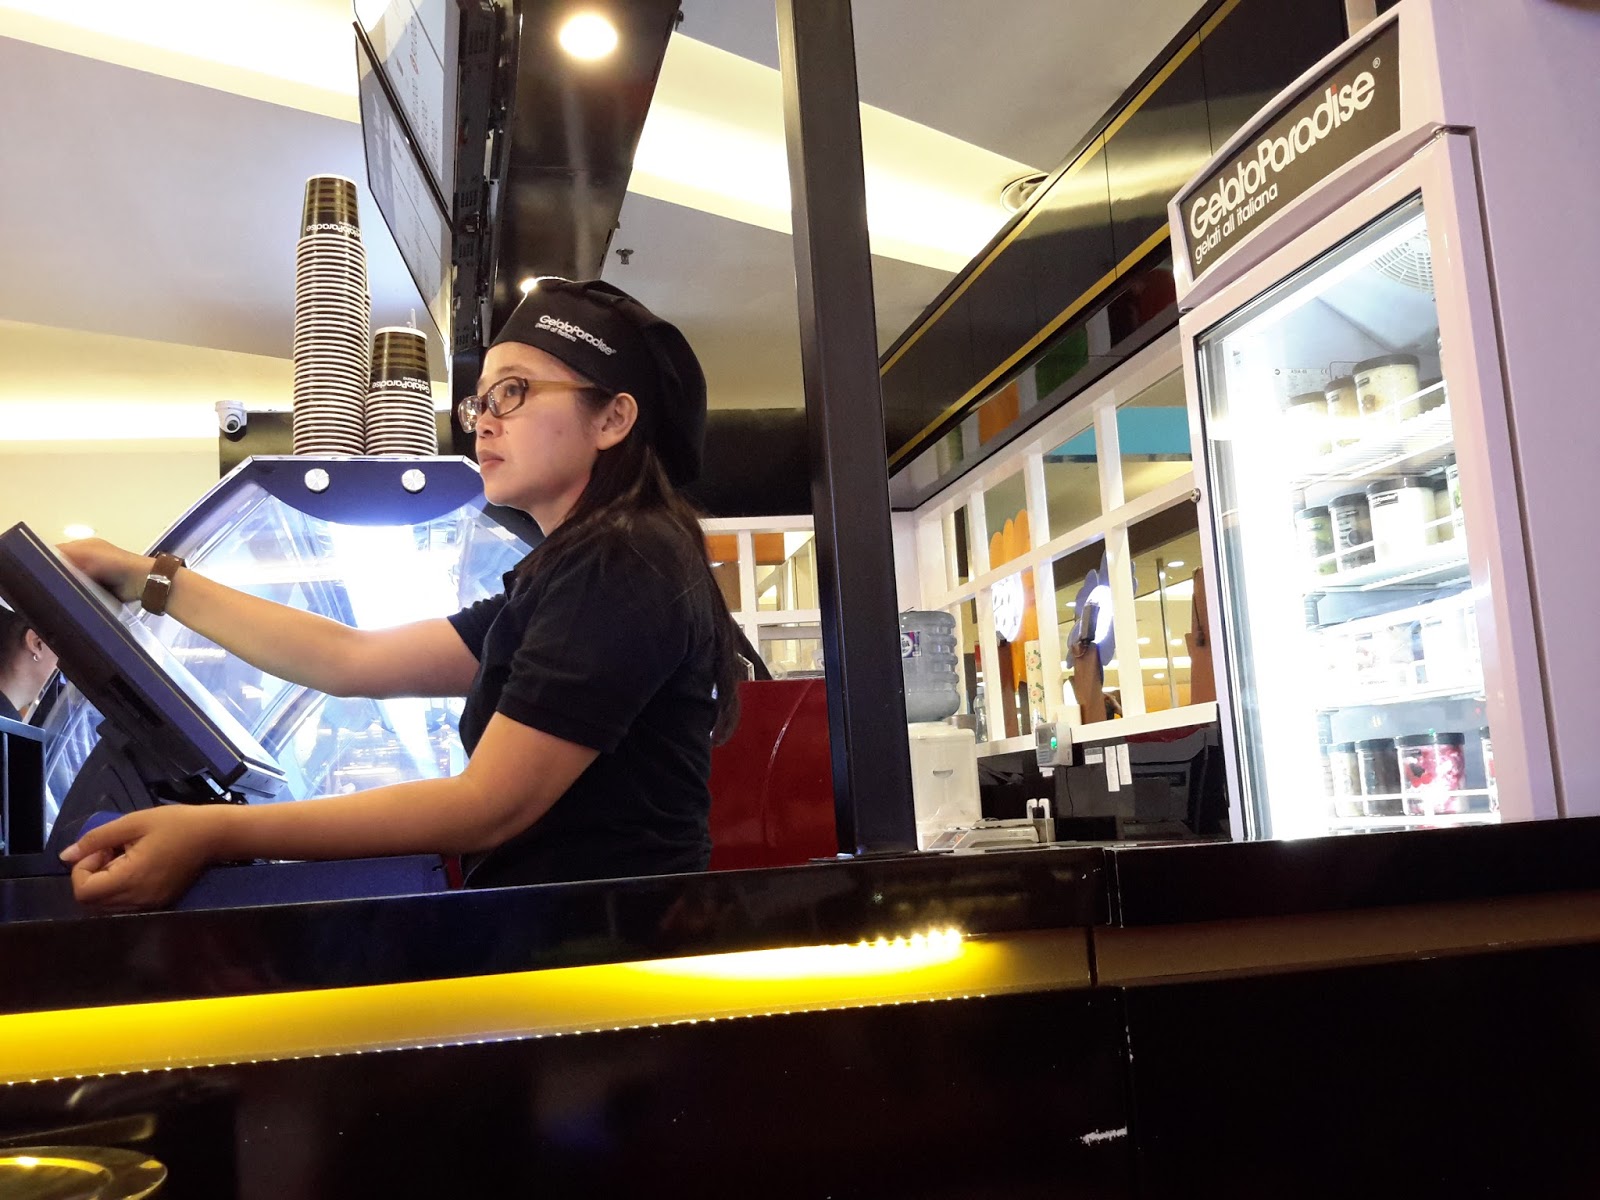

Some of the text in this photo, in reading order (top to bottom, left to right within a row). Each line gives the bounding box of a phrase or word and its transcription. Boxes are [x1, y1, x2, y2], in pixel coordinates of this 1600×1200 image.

[1190, 71, 1375, 239] GelatoParadise
[1195, 182, 1278, 265] gelati all italiana
